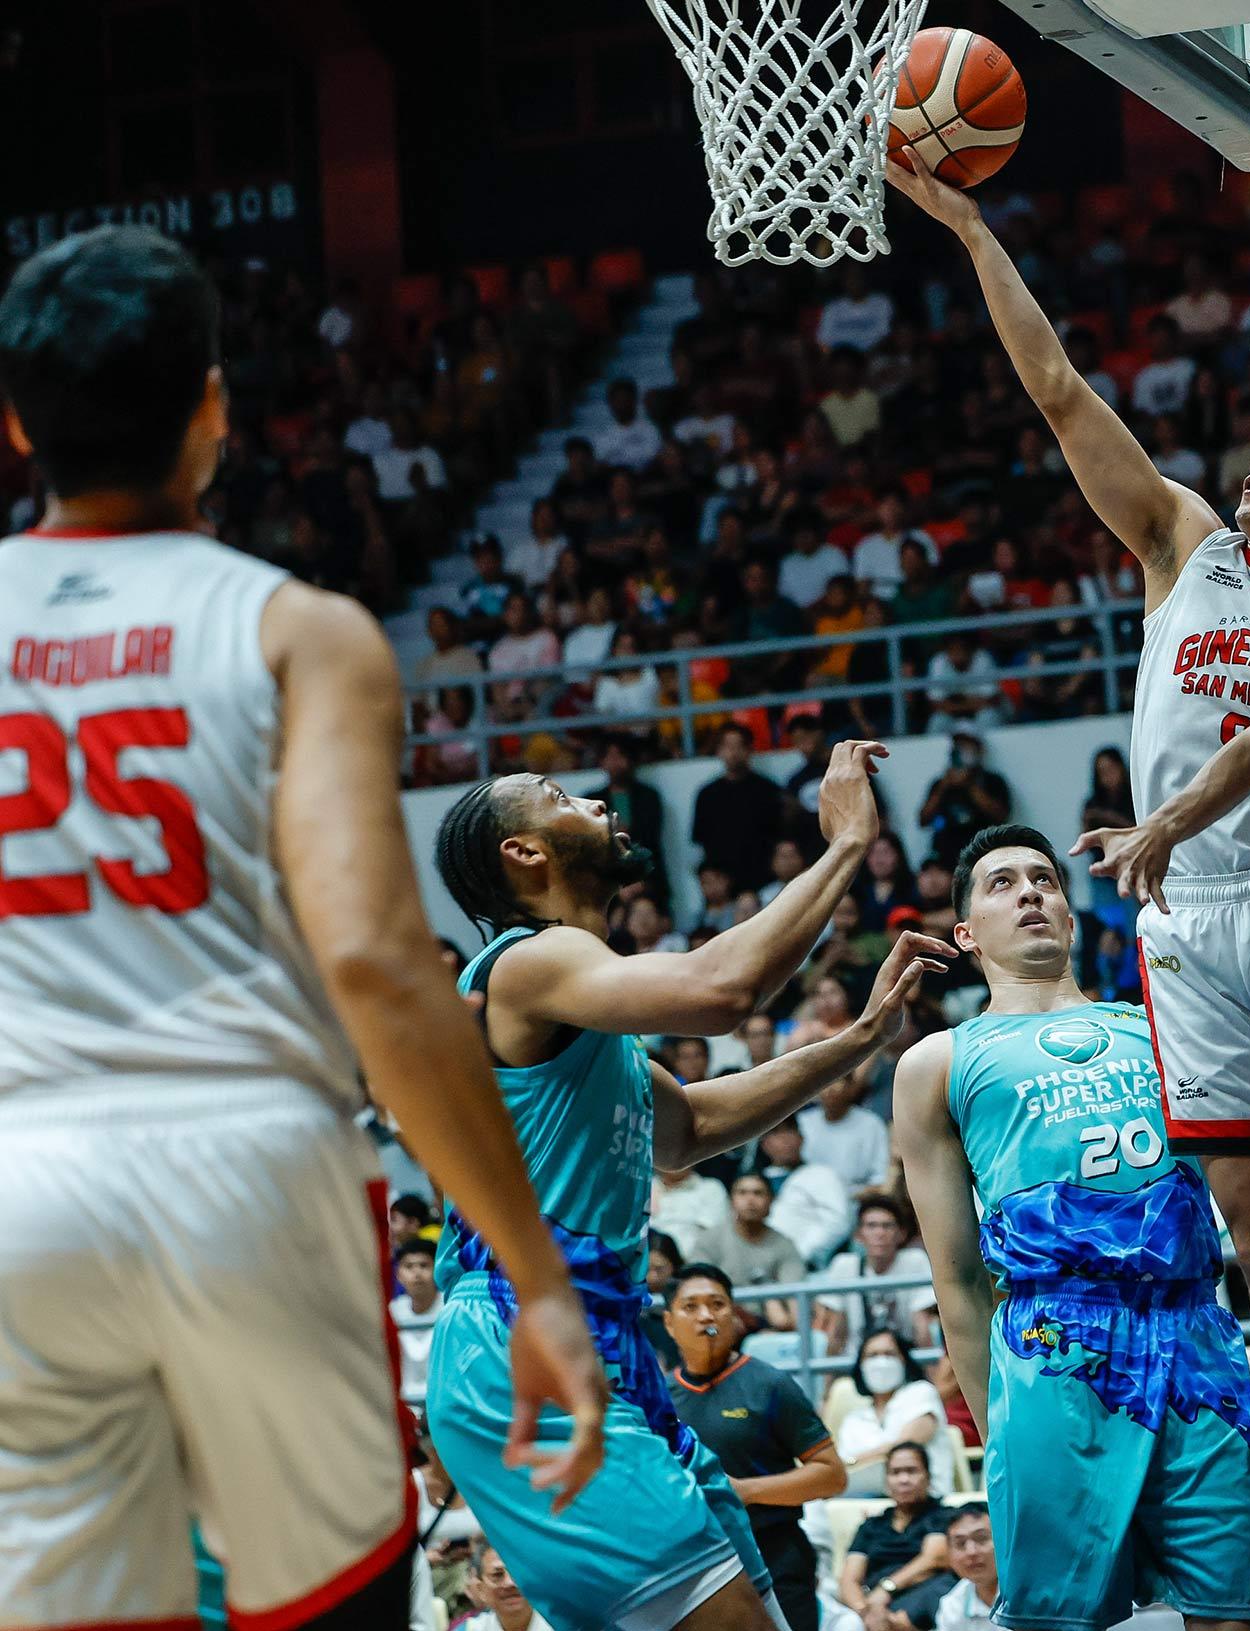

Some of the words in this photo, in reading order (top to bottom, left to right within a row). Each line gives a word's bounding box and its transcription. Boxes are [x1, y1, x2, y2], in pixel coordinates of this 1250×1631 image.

[1205, 574, 1244, 590] BALANCE
[1212, 570, 1242, 584] WORLD
[12, 625, 173, 687] AGUILAR
[1181, 672, 1227, 698] SAN
[0, 706, 209, 920] 25
[1014, 1058, 1160, 1099] PHOENIX
[1026, 1081, 1114, 1120] SUPER
[1079, 1116, 1165, 1179] 20
